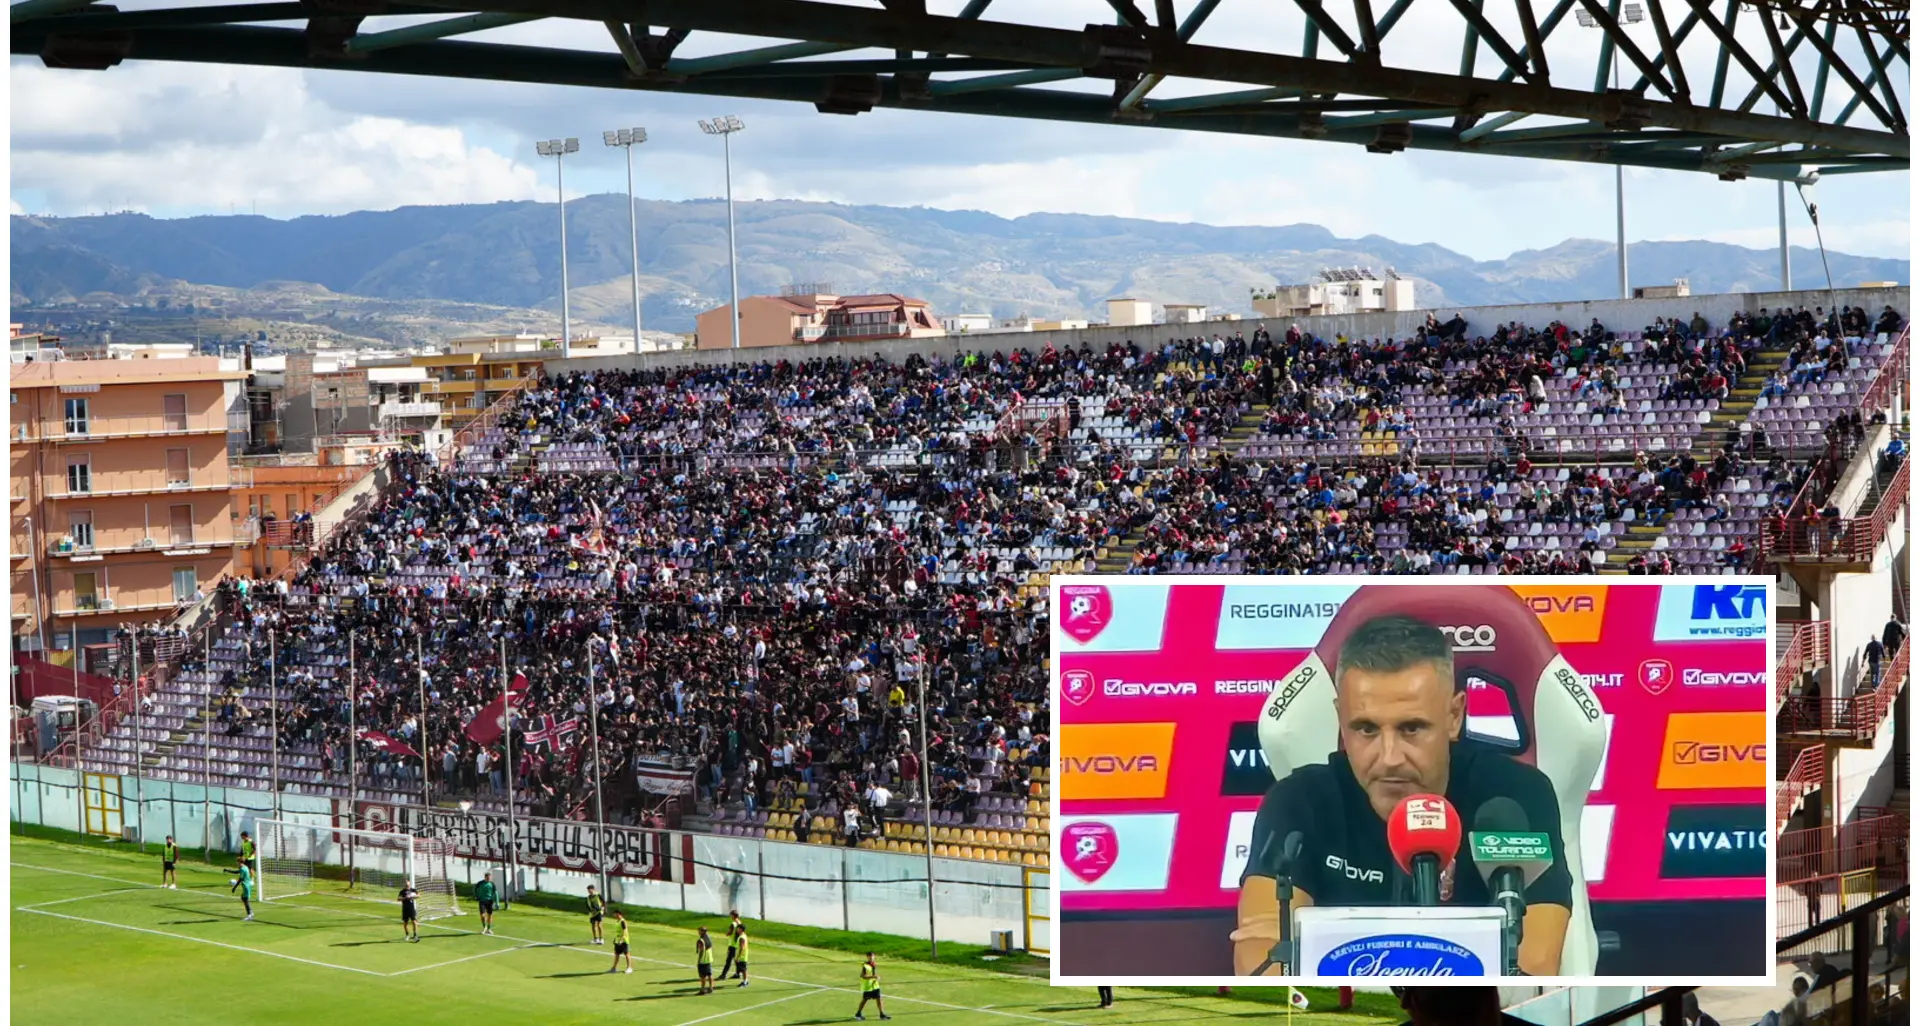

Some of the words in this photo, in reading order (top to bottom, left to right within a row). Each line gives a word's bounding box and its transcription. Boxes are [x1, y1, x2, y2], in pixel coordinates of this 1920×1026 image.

[1121, 682, 1197, 695] GIVOVA
[1268, 666, 1313, 719] sparco
[1556, 668, 1600, 720] sparco
[1060, 756, 1157, 773] IVOVA
[528, 821, 557, 854] GLI
[1502, 837, 1542, 845] VIDEO
[1477, 846, 1534, 854] TOURING
[1366, 941, 1405, 950] FUNEBRI
